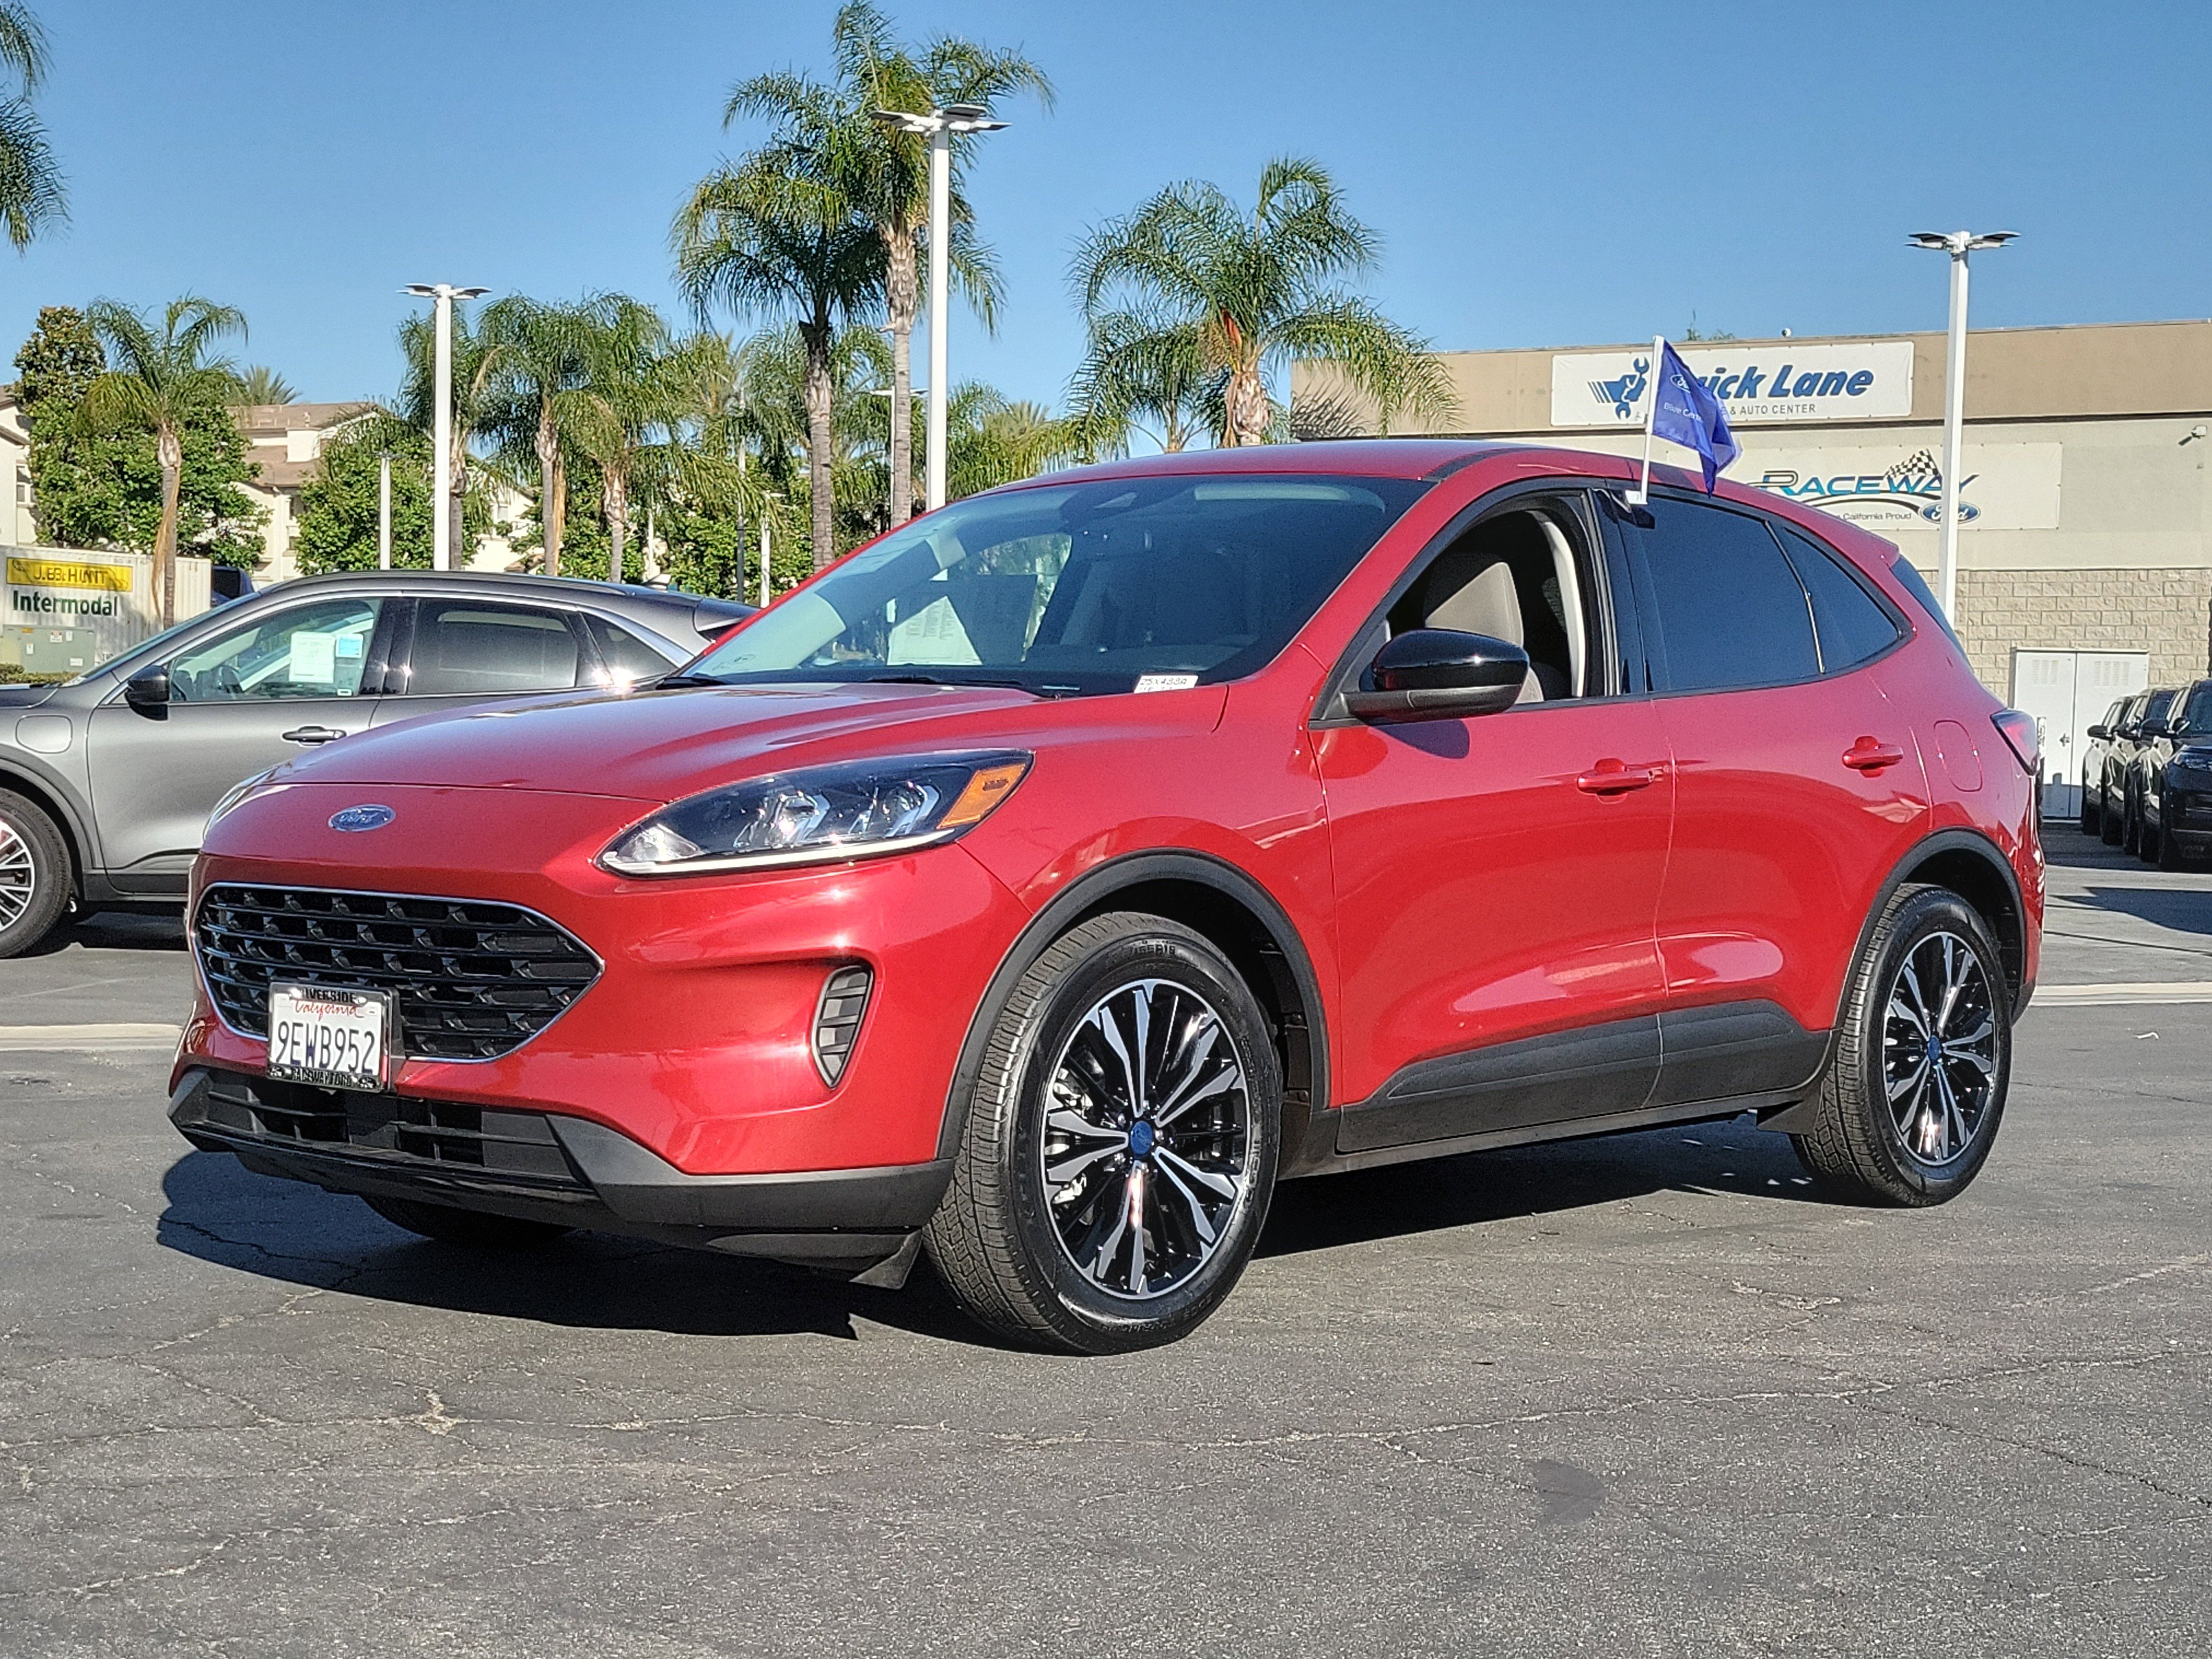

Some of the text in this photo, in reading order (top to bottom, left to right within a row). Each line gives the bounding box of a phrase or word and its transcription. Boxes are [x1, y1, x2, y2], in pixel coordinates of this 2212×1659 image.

[1768, 364, 1874, 398] Lane
[1730, 406, 1736, 415] &
[1740, 404, 1768, 415] AUTO
[1772, 404, 1816, 414] CENTER
[13, 590, 119, 617] Intermodal
[295, 999, 364, 1021] California
[276, 1020, 375, 1075] 9EWB952
